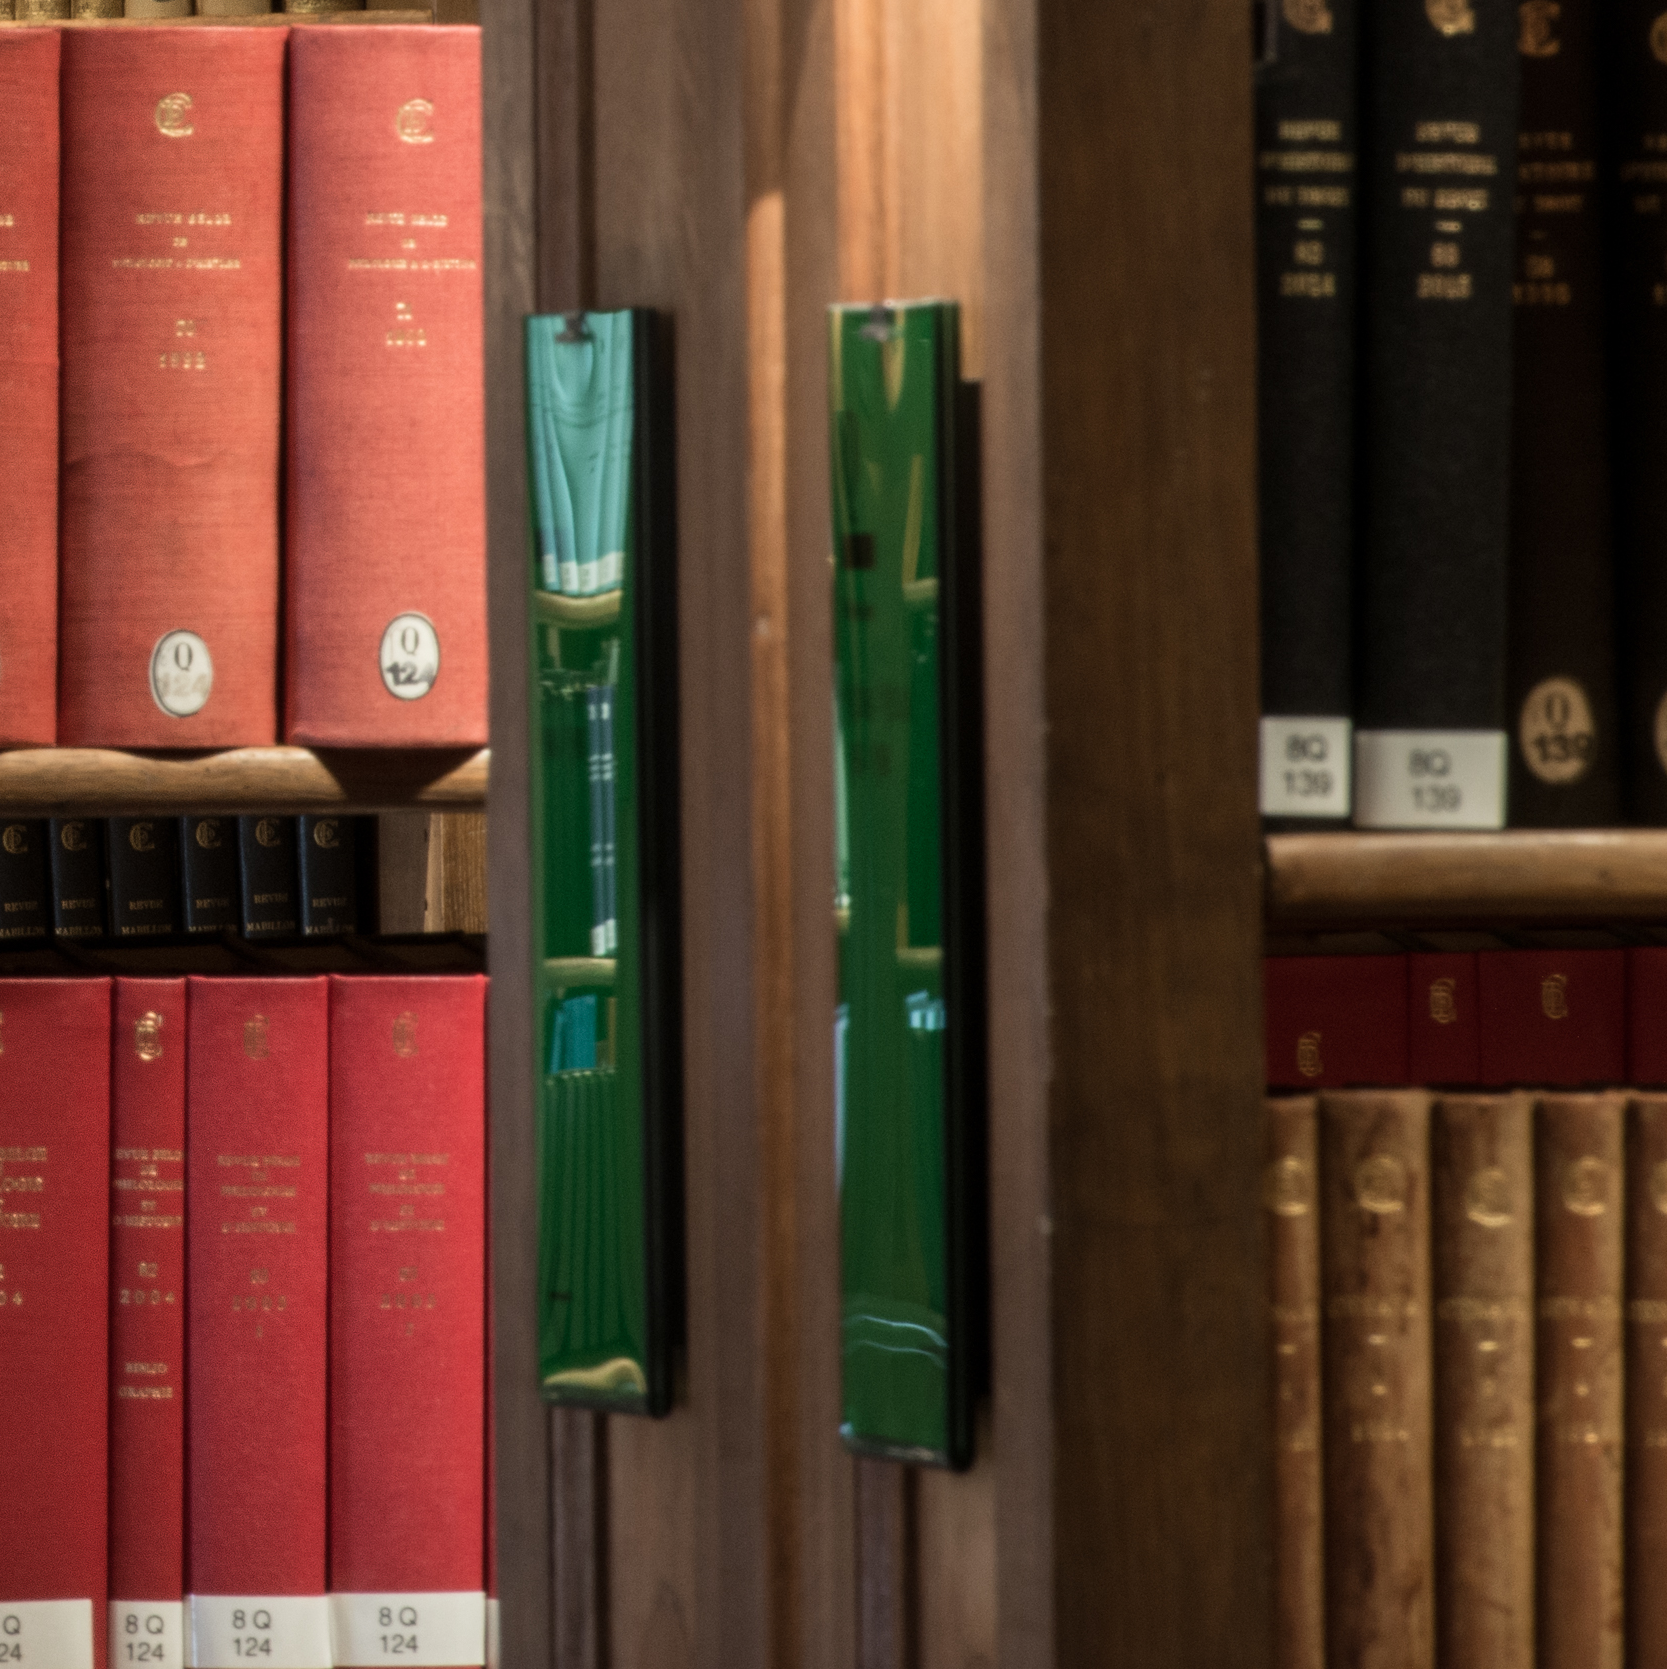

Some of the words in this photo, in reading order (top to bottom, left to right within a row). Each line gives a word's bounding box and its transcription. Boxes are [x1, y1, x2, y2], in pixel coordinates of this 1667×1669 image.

[3, 1615, 20, 1635] Q
[380, 1608, 391, 1625] 8
[399, 1607, 417, 1627] Q
[381, 1634, 417, 1653] 124
